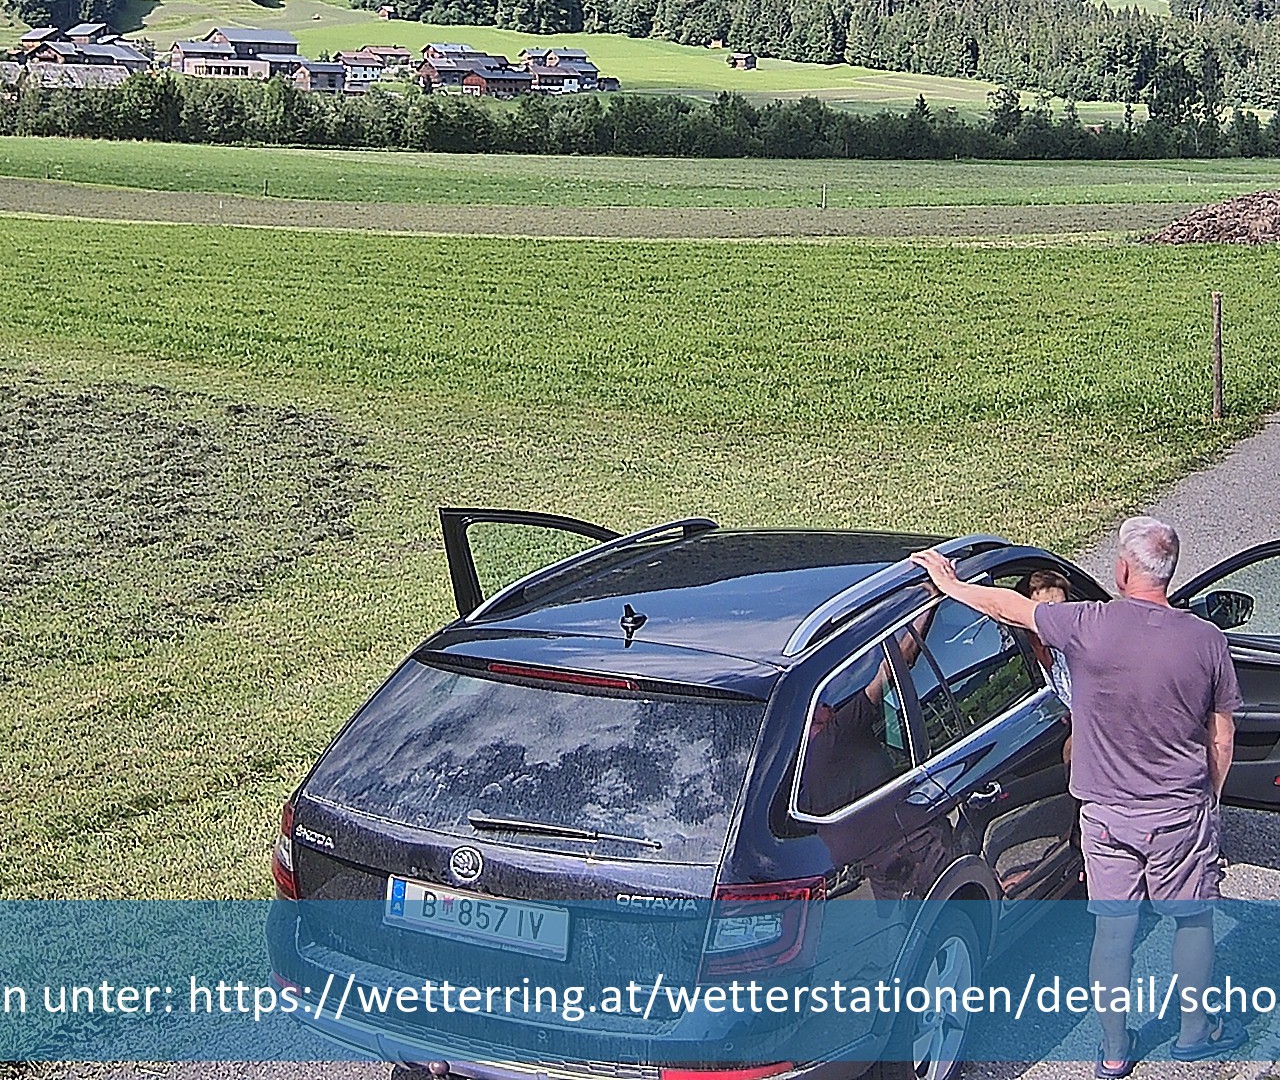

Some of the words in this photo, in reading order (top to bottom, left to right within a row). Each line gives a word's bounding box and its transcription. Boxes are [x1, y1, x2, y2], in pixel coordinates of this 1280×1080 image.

[422, 891, 437, 919] B
[458, 899, 509, 933] 857
[518, 910, 544, 940] IV
[616, 894, 697, 911] OCTAVIA
